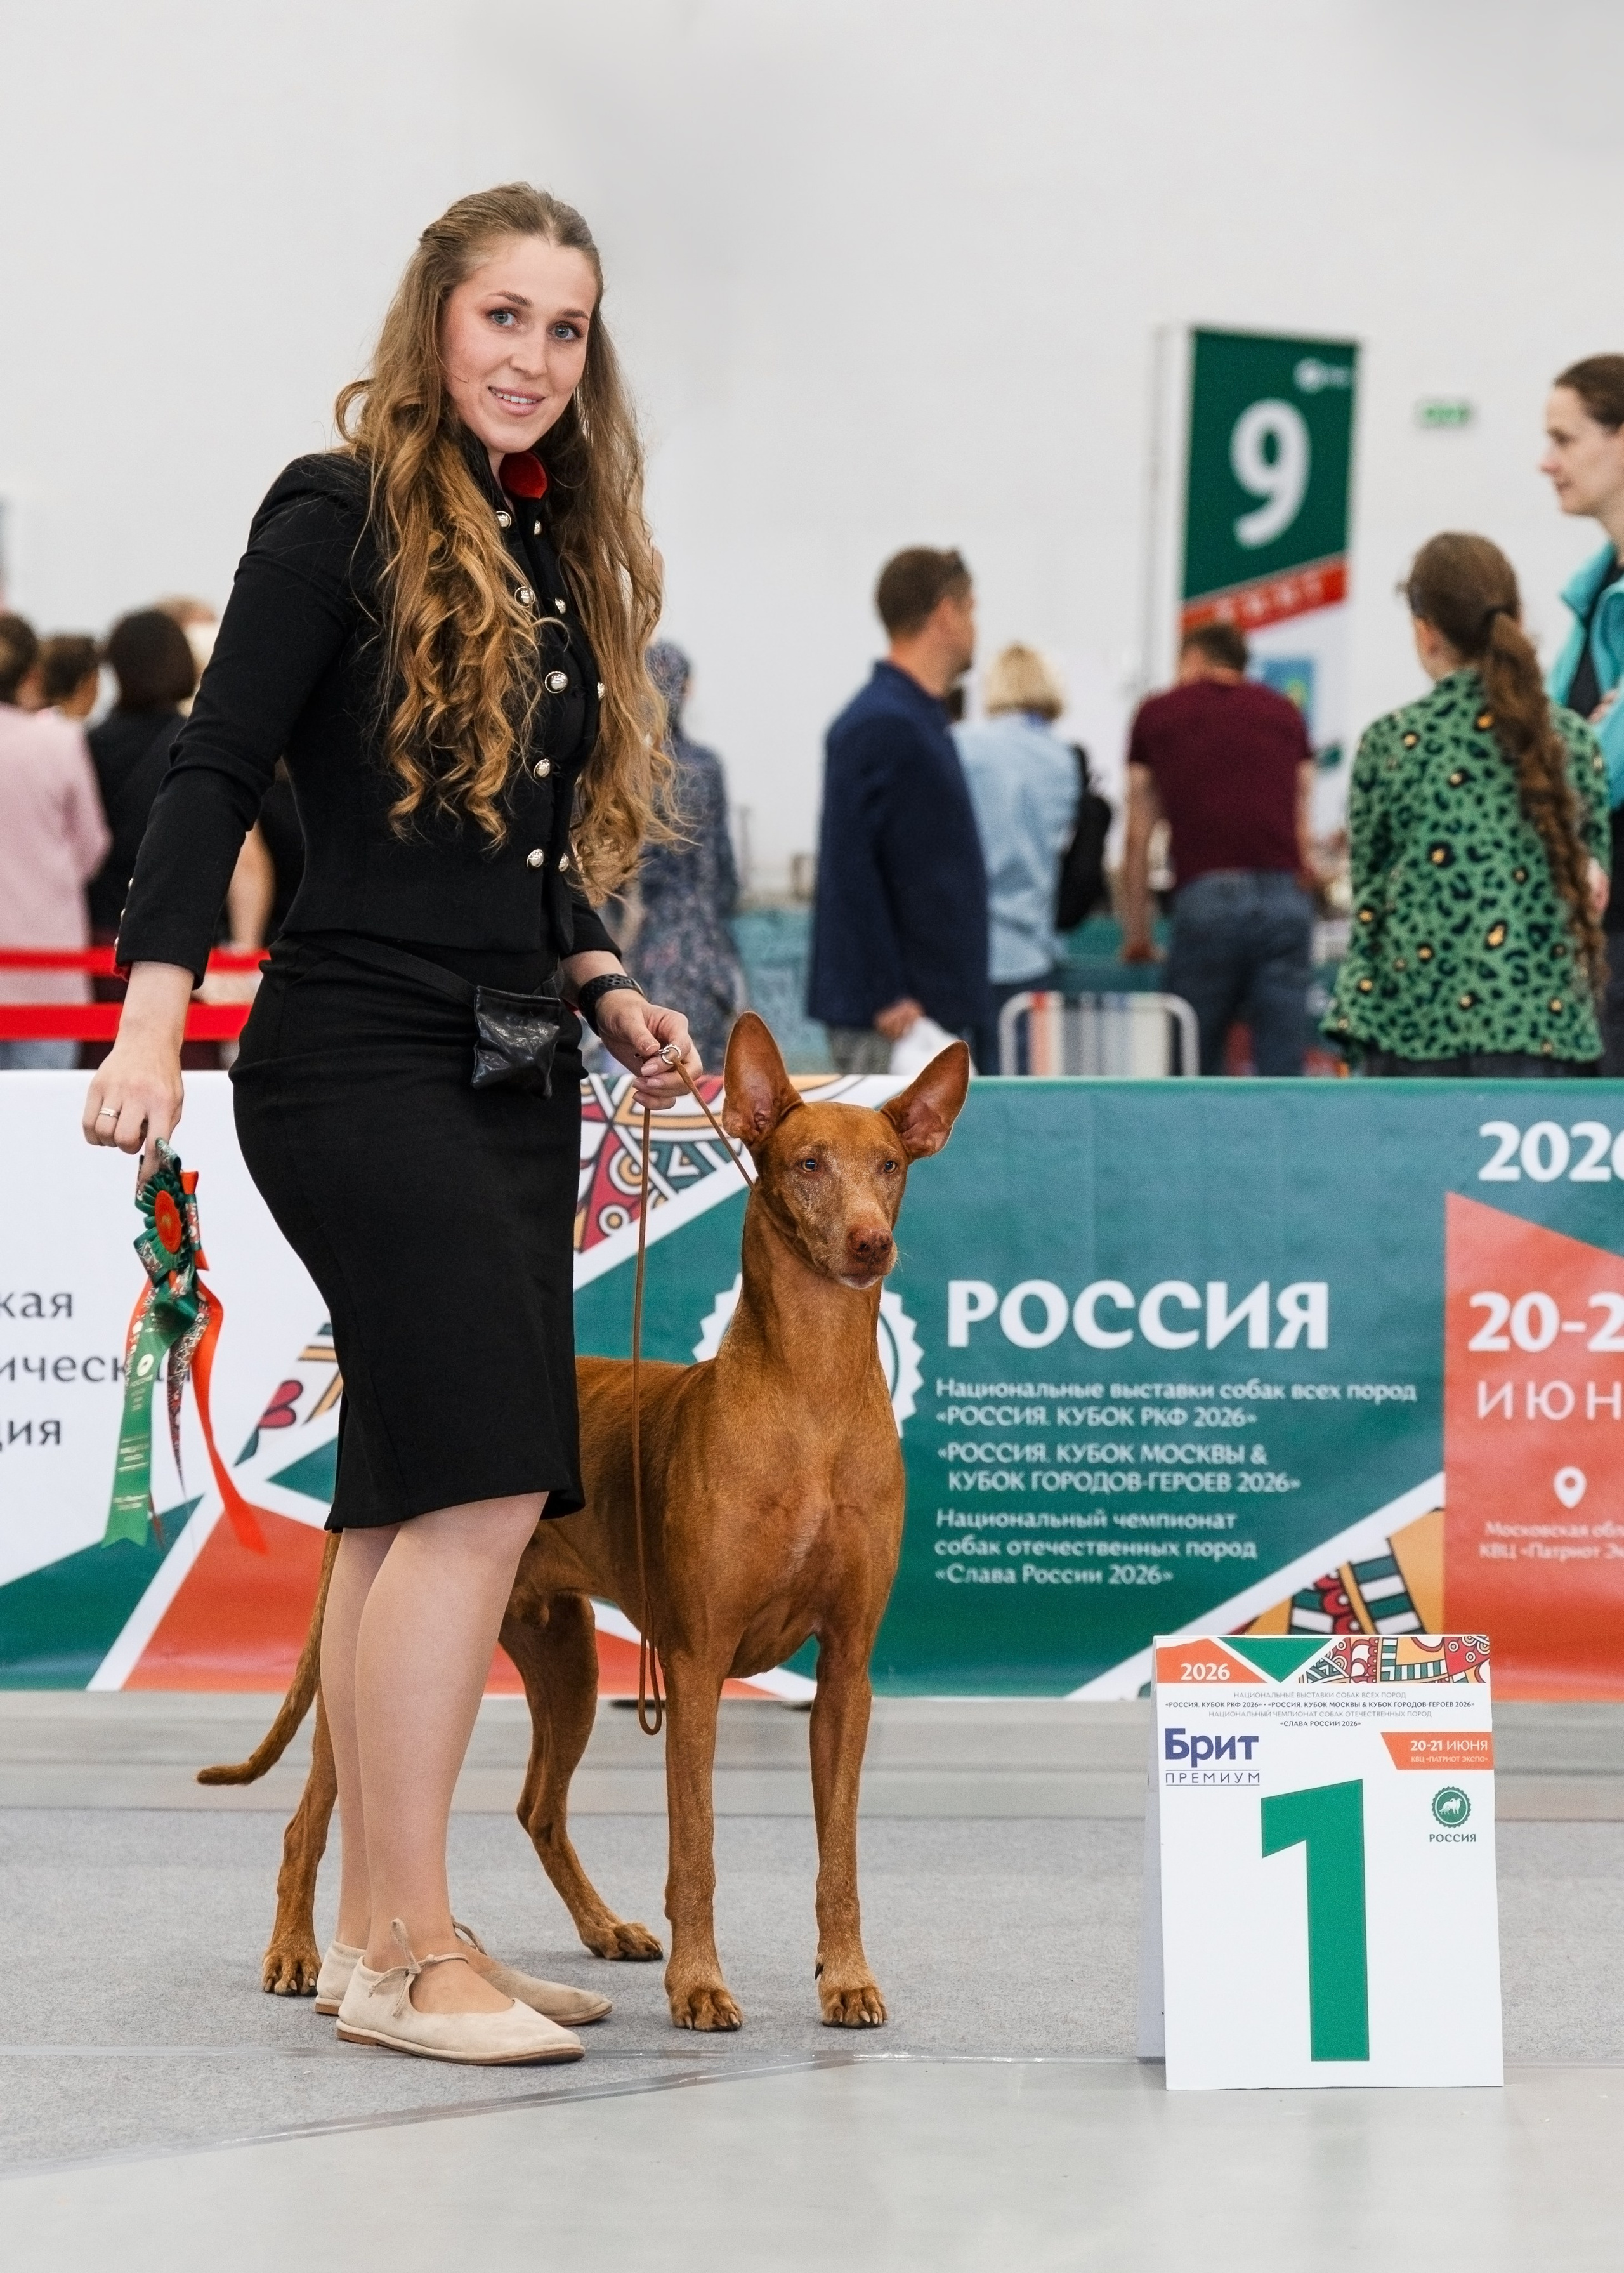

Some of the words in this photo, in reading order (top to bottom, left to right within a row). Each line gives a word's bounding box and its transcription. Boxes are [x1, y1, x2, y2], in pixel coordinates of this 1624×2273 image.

[1229, 397, 1311, 549] 9
[1477, 1120, 1624, 1183] 202
[948, 1279, 1328, 1350] РОССИЯ
[936, 1378, 1104, 1400] Национальные
[1110, 1383, 1215, 1399] выставки
[1219, 1378, 1285, 1400] собак
[1291, 1384, 1341, 1400] всех
[1347, 1384, 1417, 1406] пород
[1477, 1380, 1622, 1421] ИЮН
[1057, 1405, 1135, 1426] КУБОК
[1141, 1406, 1188, 1427] РКФ
[1193, 1406, 1257, 1428] 2026»
[1057, 1442, 1135, 1464] КУБОК
[1141, 1443, 1245, 1465] МОСКВЫ
[1250, 1444, 1267, 1465] &
[949, 1470, 1025, 1491] КУБОК
[1031, 1470, 1232, 1495] ГОРОДОВ-ГЕРОЕВ
[1238, 1471, 1301, 1492] 2026»
[937, 1508, 1108, 1530] Национальный
[1113, 1513, 1236, 1529] чемпионат
[934, 1534, 1001, 1556] собак
[1007, 1541, 1180, 1557] отечественных
[1186, 1541, 1257, 1562] пород
[935, 1562, 1016, 1584] «Слава
[1022, 1562, 1103, 1585] России
[1108, 1563, 1174, 1585] 2026»
[1181, 1663, 1231, 1681] 2026
[1208, 1710, 1271, 1718] НАЦИОНАЛЬНЫЙ
[1165, 1728, 1259, 1768] Брит
[1410, 1740, 1443, 1751] 20-21
[1446, 1740, 1488, 1751] ИЮНЯ
[1166, 1772, 1260, 1783] ПРЕМИУМ
[1429, 1833, 1476, 1842] РОССИЯ
[1261, 1779, 1370, 2062] 1
